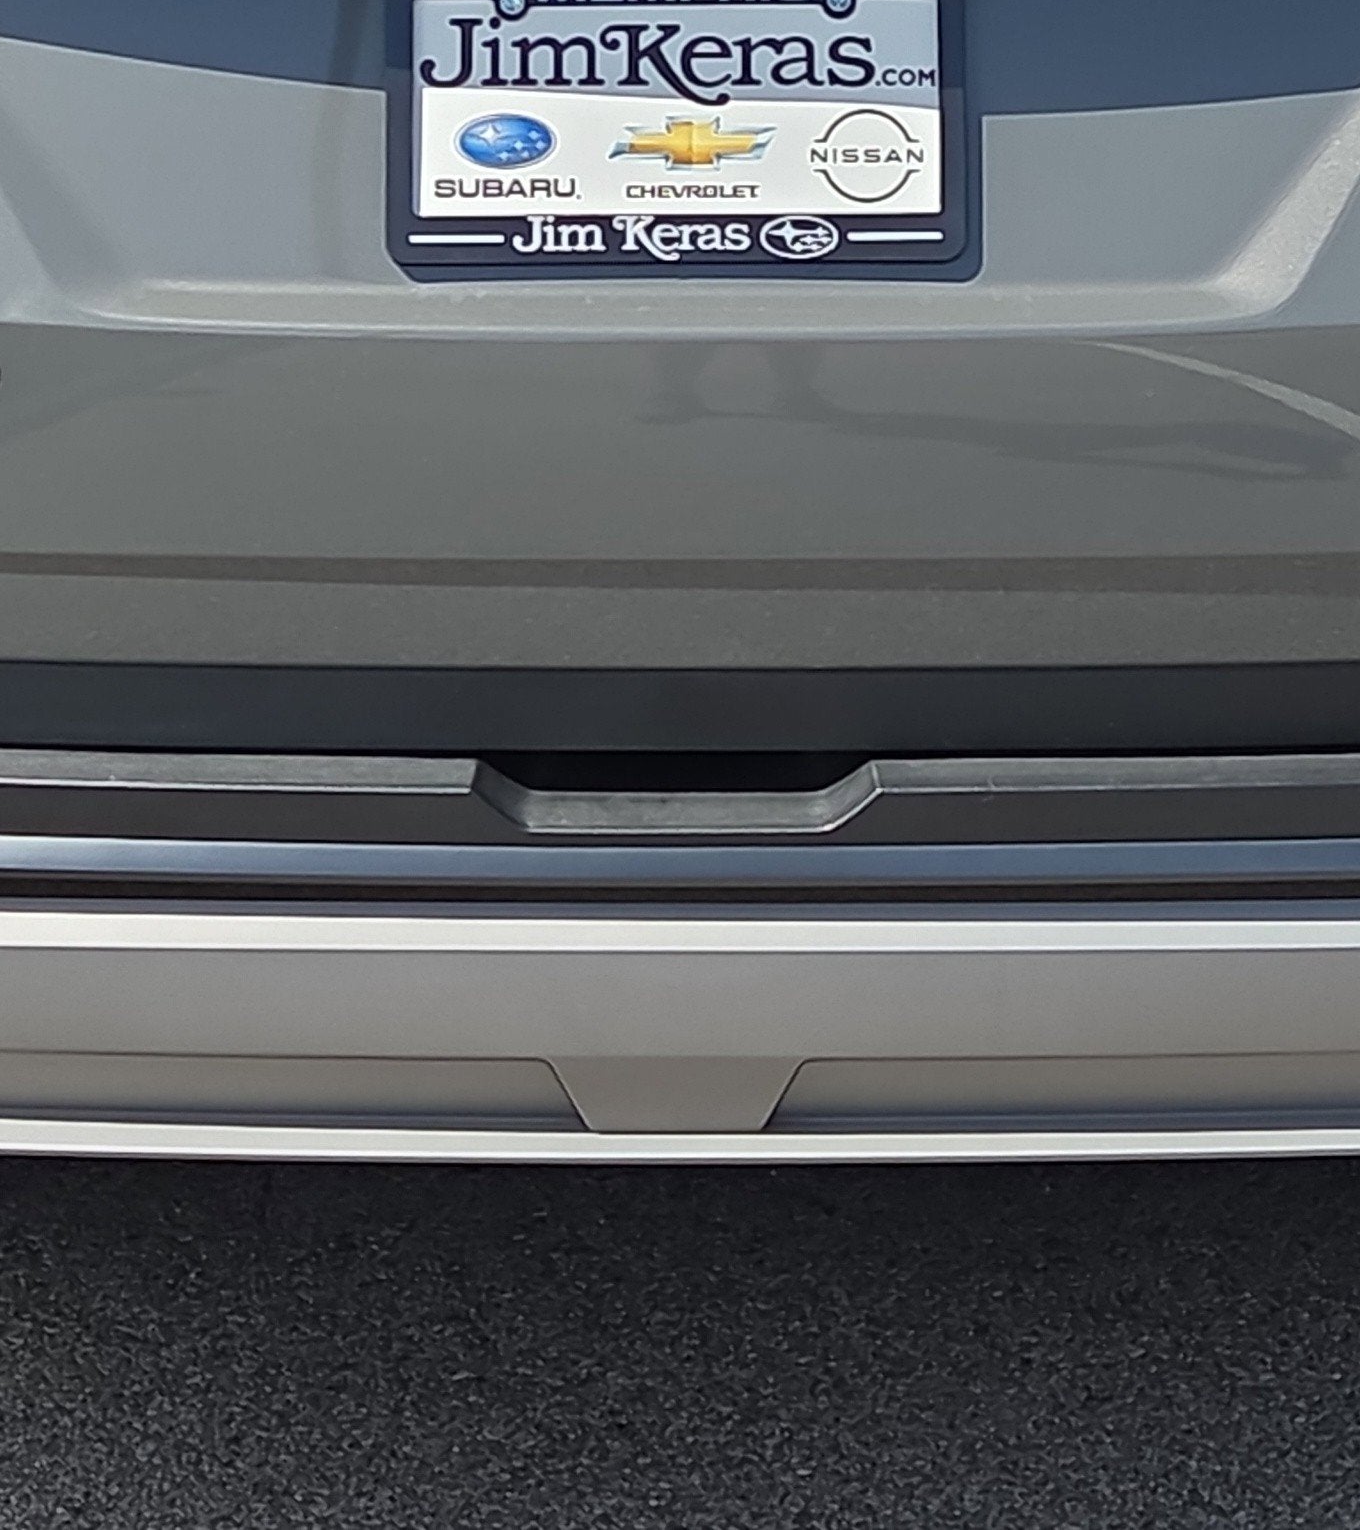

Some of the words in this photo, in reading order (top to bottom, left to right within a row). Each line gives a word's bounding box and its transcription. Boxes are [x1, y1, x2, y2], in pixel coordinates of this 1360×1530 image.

[811, 145, 924, 164] NISSAN
[434, 179, 576, 199] SUBARU
[626, 184, 759, 199] CHEVROLET
[512, 216, 606, 253] Jim
[612, 219, 752, 260] Keras
